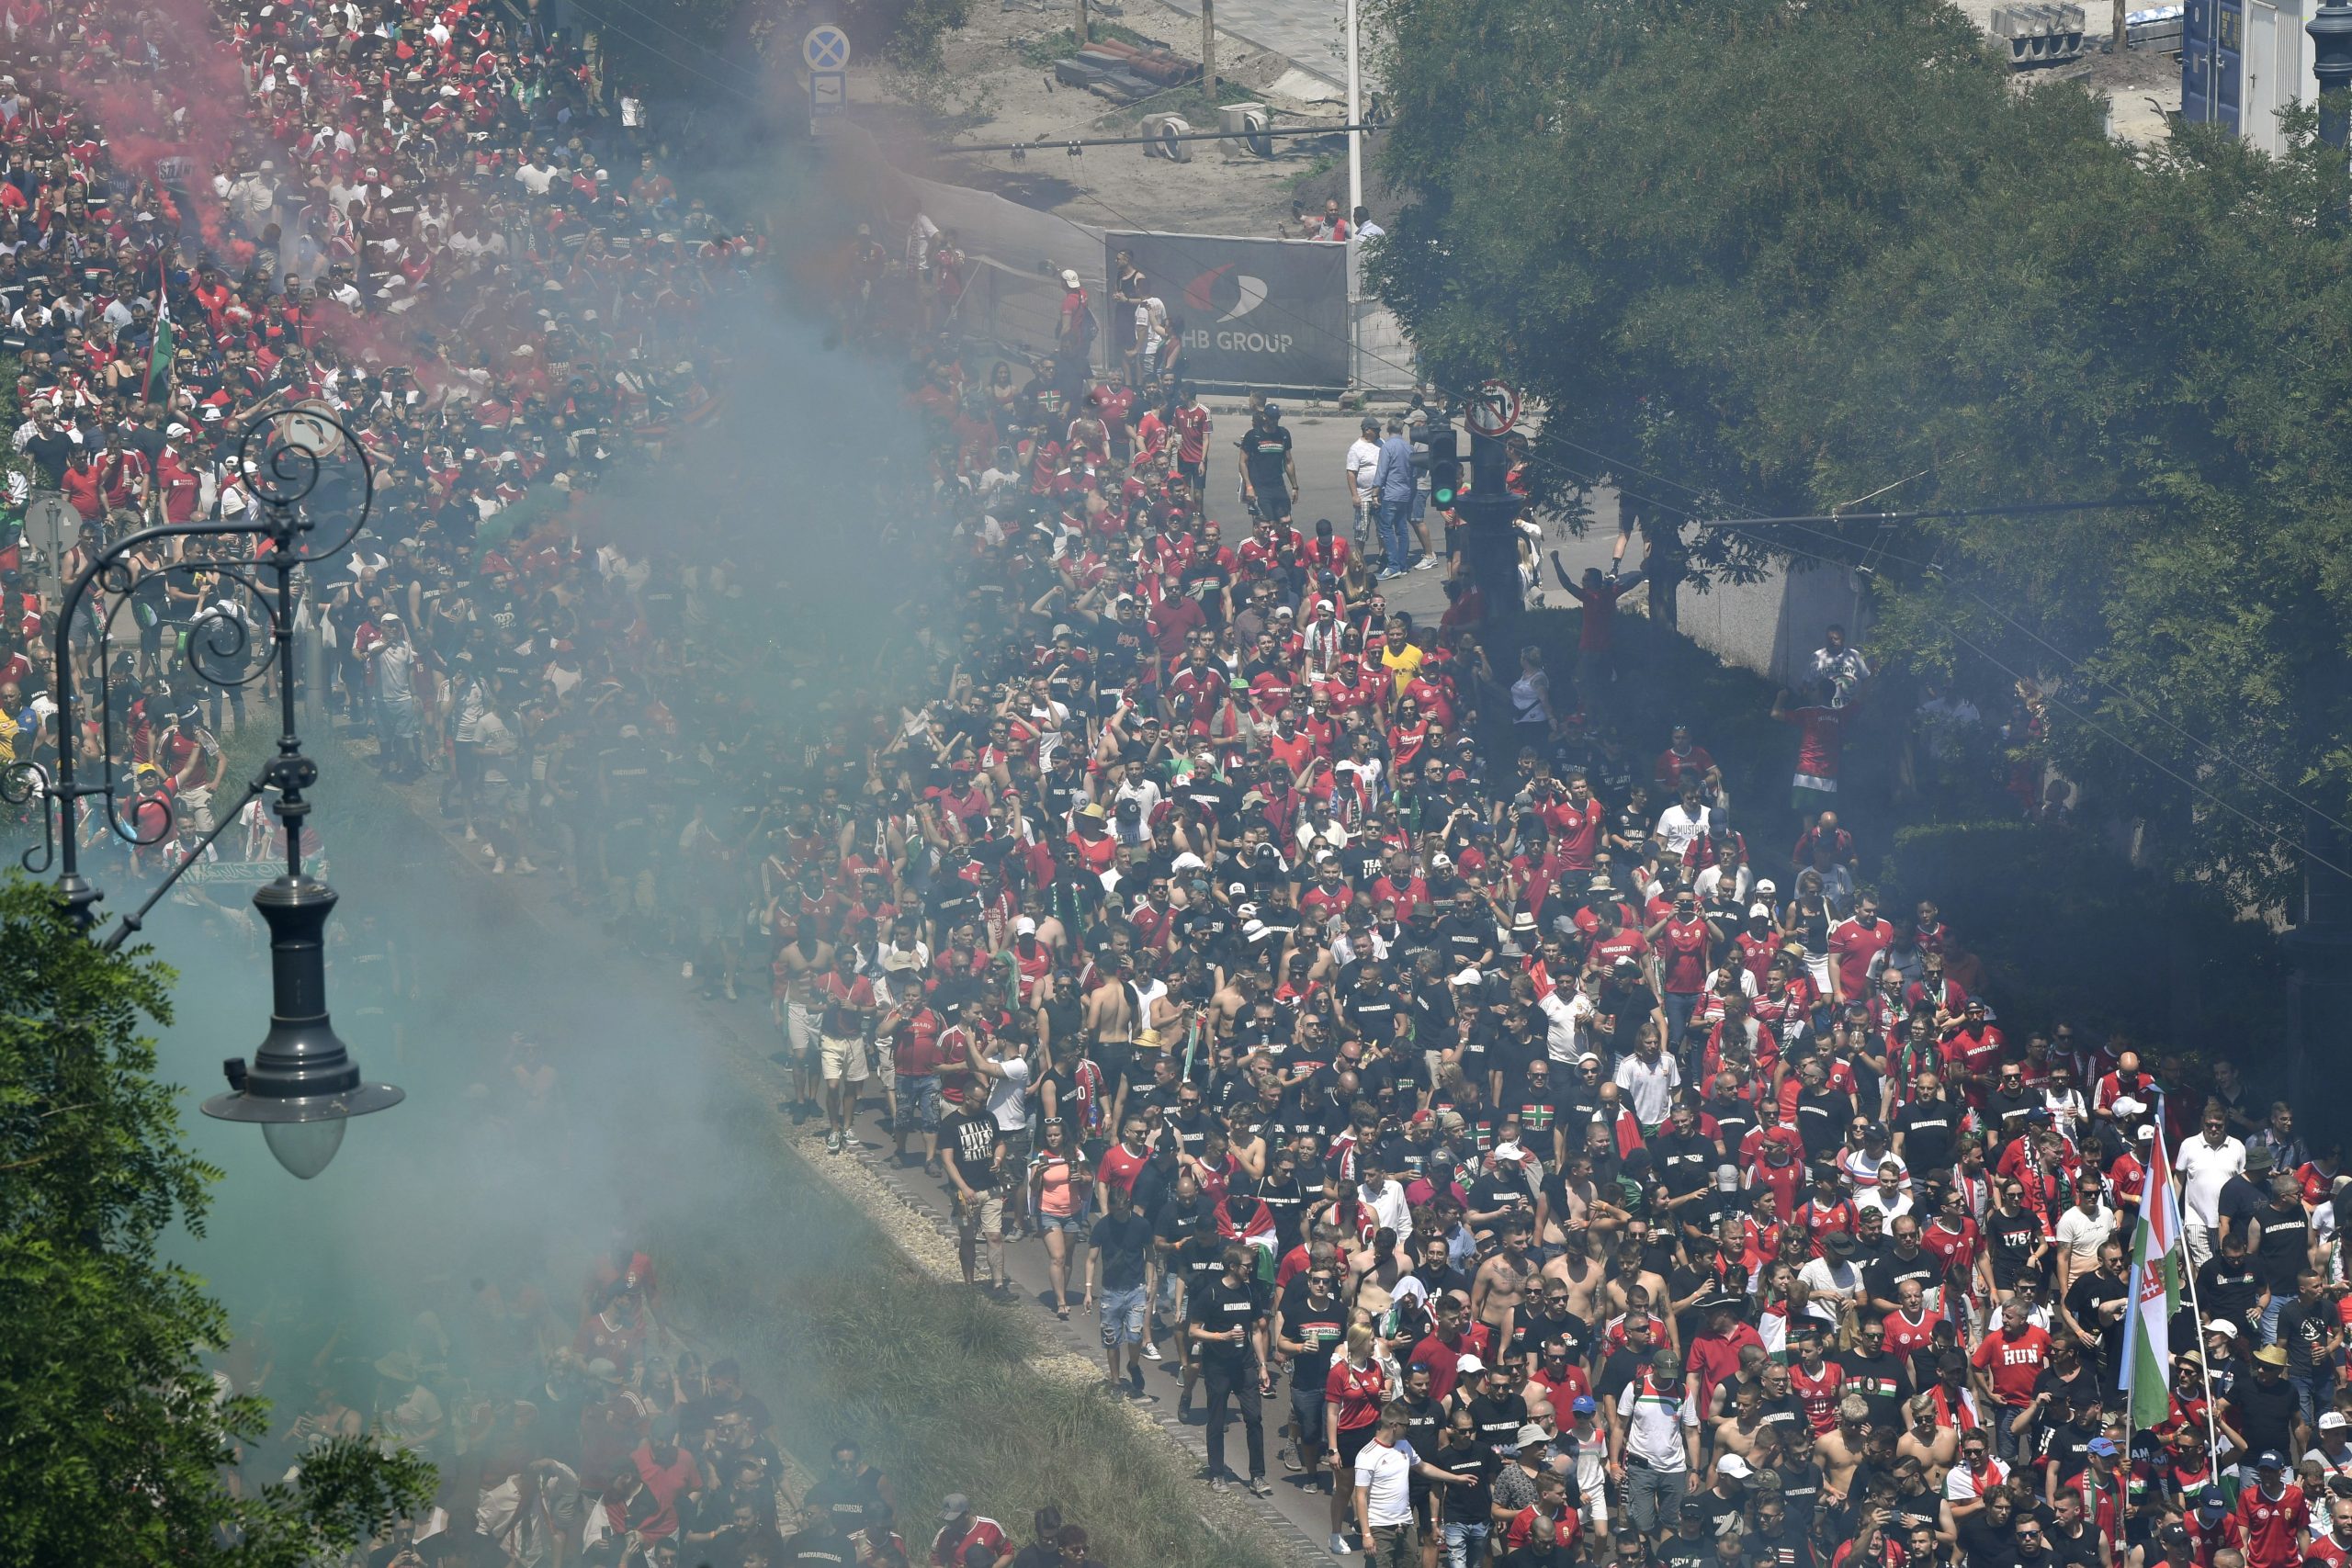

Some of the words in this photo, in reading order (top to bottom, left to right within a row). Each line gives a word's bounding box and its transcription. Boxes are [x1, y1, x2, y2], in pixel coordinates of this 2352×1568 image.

[1182, 329, 1210, 349] HB
[1216, 331, 1293, 353] GROUP
[1199, 691, 1204, 704] 7
[1400, 734, 1425, 745] Hungary
[1190, 794, 1220, 803] MAGYARORSZÁG
[1363, 859, 1382, 868] TEA
[1601, 945, 1632, 953] HUNGARY
[1358, 1003, 1391, 1012] MAGYARORSZÁG
[1967, 1043, 2000, 1056] HUNGARY
[2025, 1076, 2050, 1086] BUDAPES
[1911, 1119, 1947, 1130] MAGYARORSZÁG
[962, 1130, 993, 1149] LIVES
[2266, 1220, 2305, 1233] MAGYARORSZÁG
[2004, 1348, 2039, 1366] HUN
[1813, 1399, 1826, 1414] 10
[1452, 1461, 1482, 1470] MAGYARORSZÁG
[797, 1551, 842, 1563] MAGYARORSZÁG
